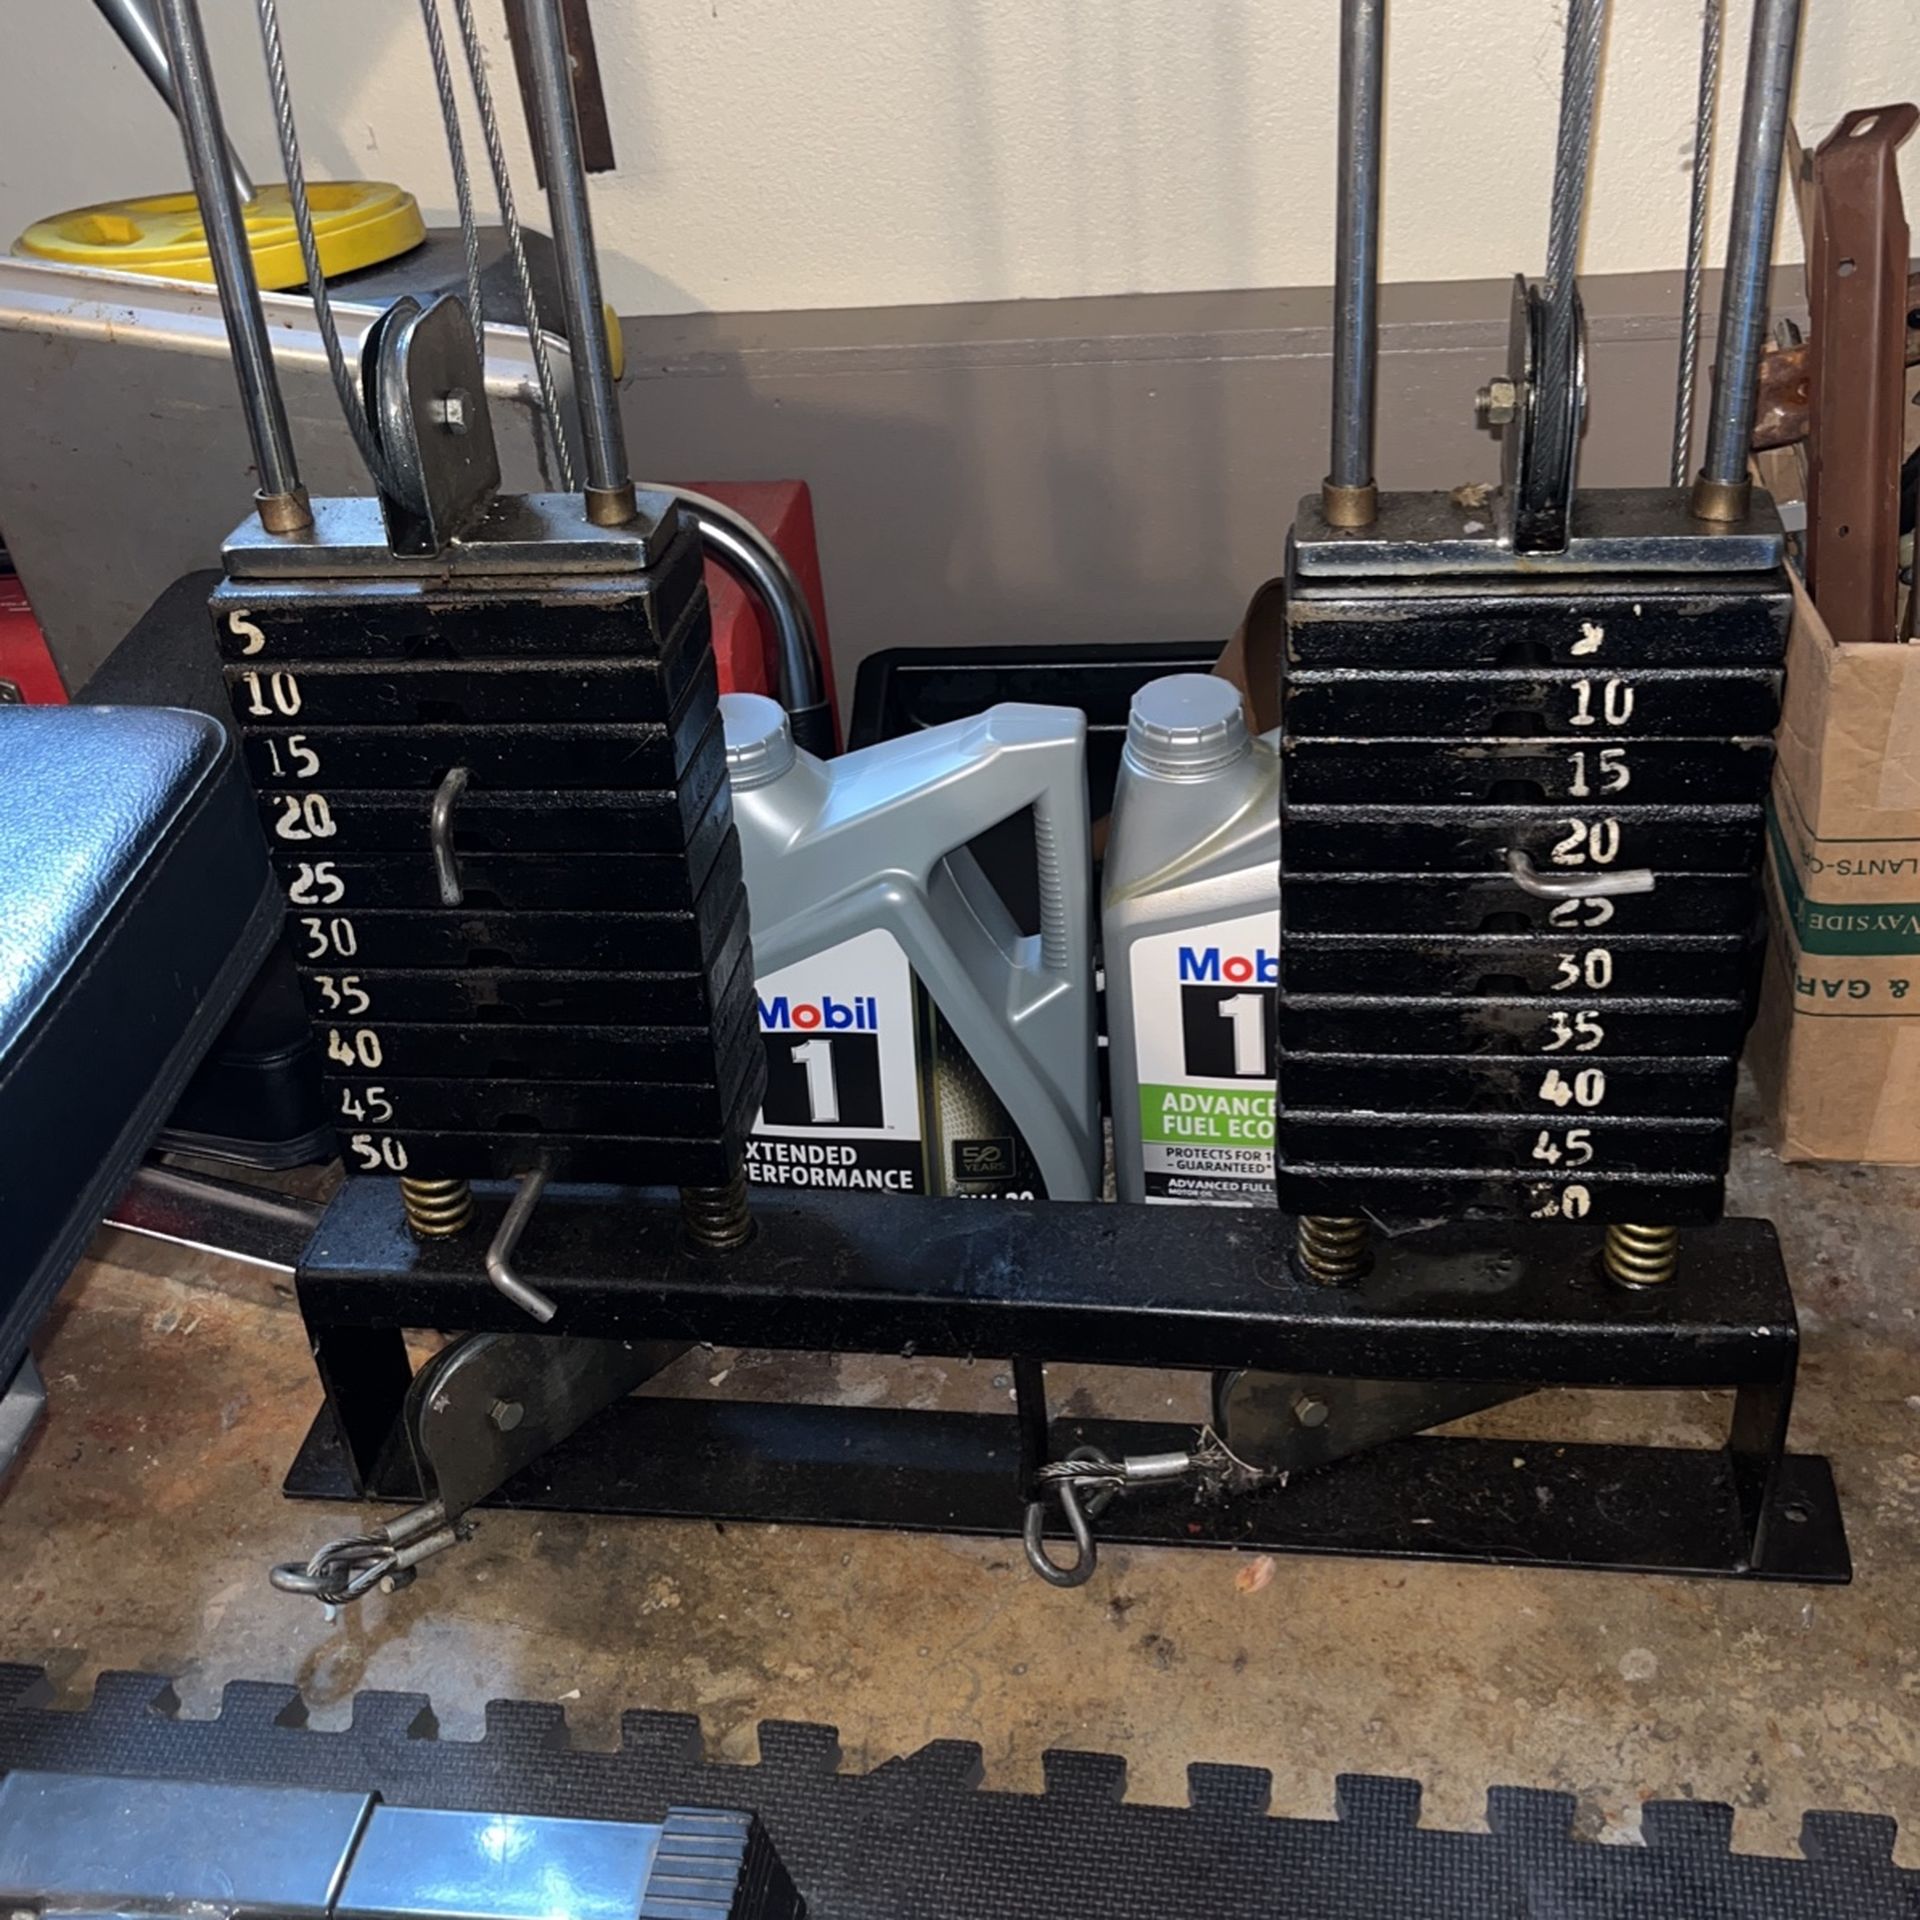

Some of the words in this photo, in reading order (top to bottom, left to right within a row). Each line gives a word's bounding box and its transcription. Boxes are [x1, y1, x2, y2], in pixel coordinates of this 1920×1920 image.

[229, 609, 265, 655] 5
[242, 668, 302, 716] 10
[1568, 678, 1634, 726] 10
[266, 734, 320, 778] 15
[1567, 748, 1630, 797] 15
[273, 793, 337, 840] 20
[1547, 816, 1620, 865] 20
[288, 861, 345, 905] 25
[300, 917, 357, 959] 30
[1551, 948, 1612, 990] 30
[1888, 979, 1910, 999] &
[314, 975, 370, 1014] 35
[758, 996, 878, 1030] Mobil
[328, 1029, 383, 1068] 40
[1219, 993, 1267, 1076] 1
[1541, 1010, 1604, 1051] 35
[791, 1039, 840, 1123] 1
[1539, 1068, 1605, 1107] 40
[341, 1086, 393, 1122] 45
[1163, 1116, 1220, 1136] FUEL
[1228, 1119, 1274, 1139] ECO
[1532, 1128, 1593, 1167] 45
[351, 1134, 408, 1170] 50
[1166, 1147, 1232, 1160] PROTECTS
[1235, 1150, 1261, 1162] FOR
[742, 1162, 914, 1189] ERFORMANCE
[1168, 1178, 1239, 1192] ADVANCED
[1242, 1182, 1273, 1193] FULL
